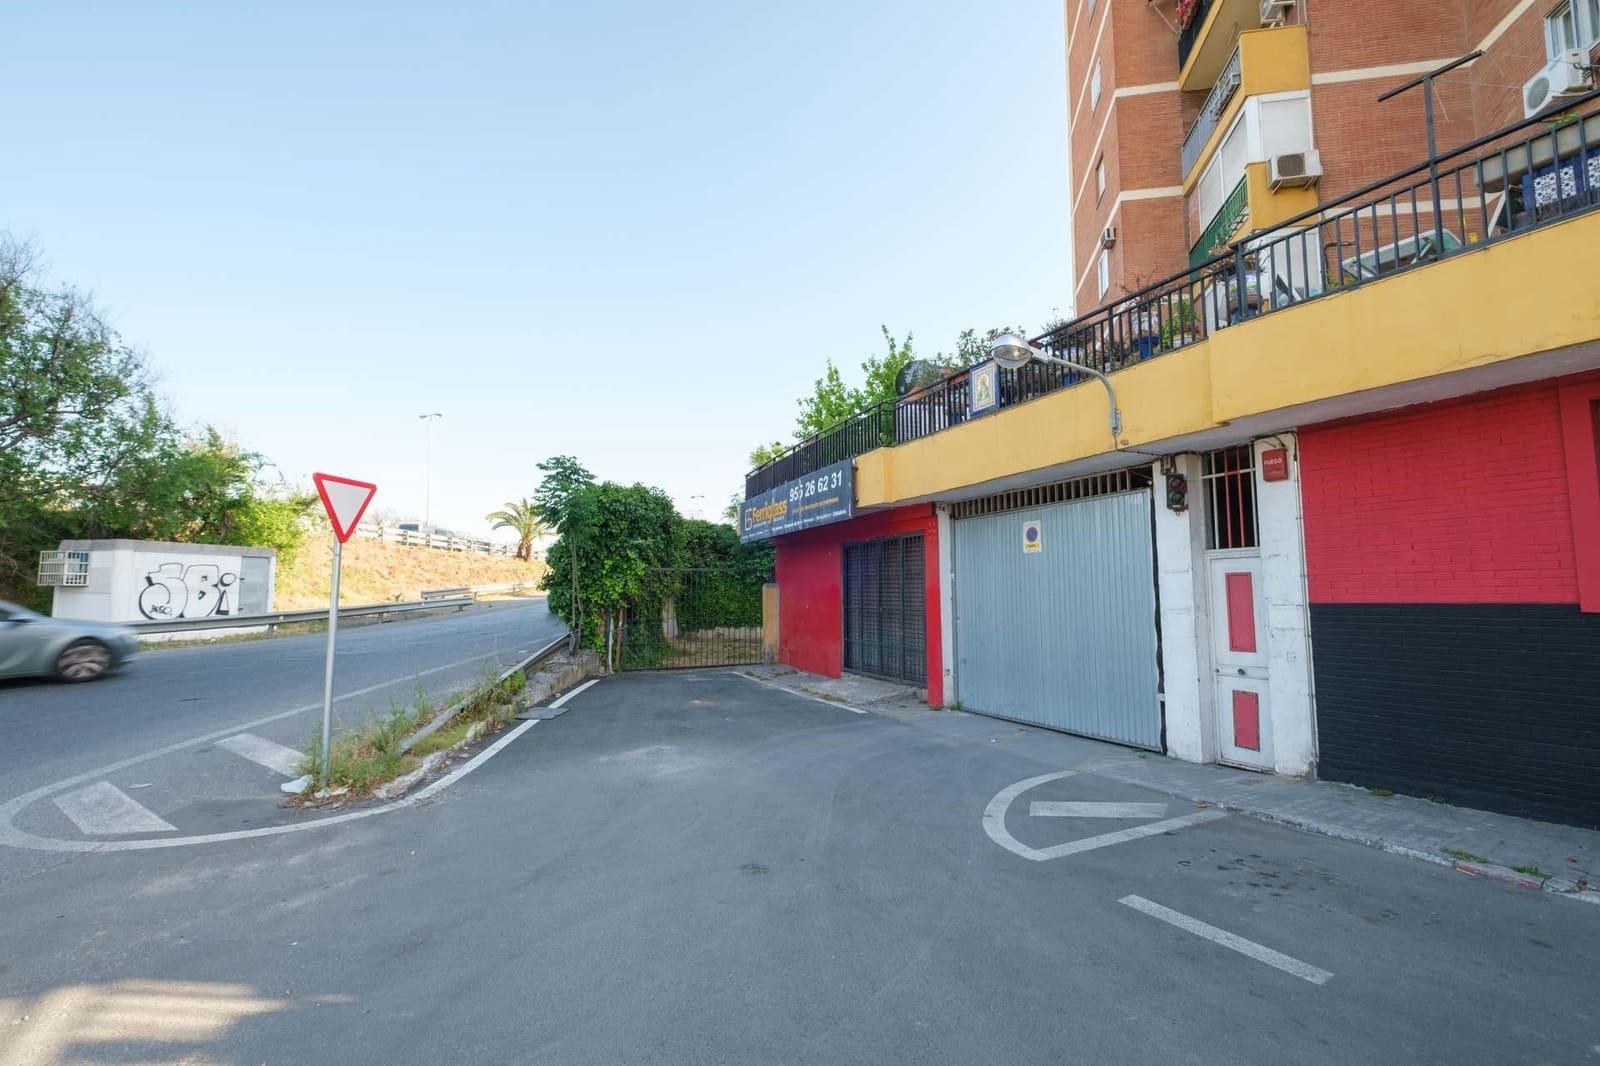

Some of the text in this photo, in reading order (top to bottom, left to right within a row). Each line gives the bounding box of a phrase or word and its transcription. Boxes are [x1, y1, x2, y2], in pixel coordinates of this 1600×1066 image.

[805, 480, 815, 497] 26
[817, 475, 829, 493] 62
[831, 470, 842, 489] 31
